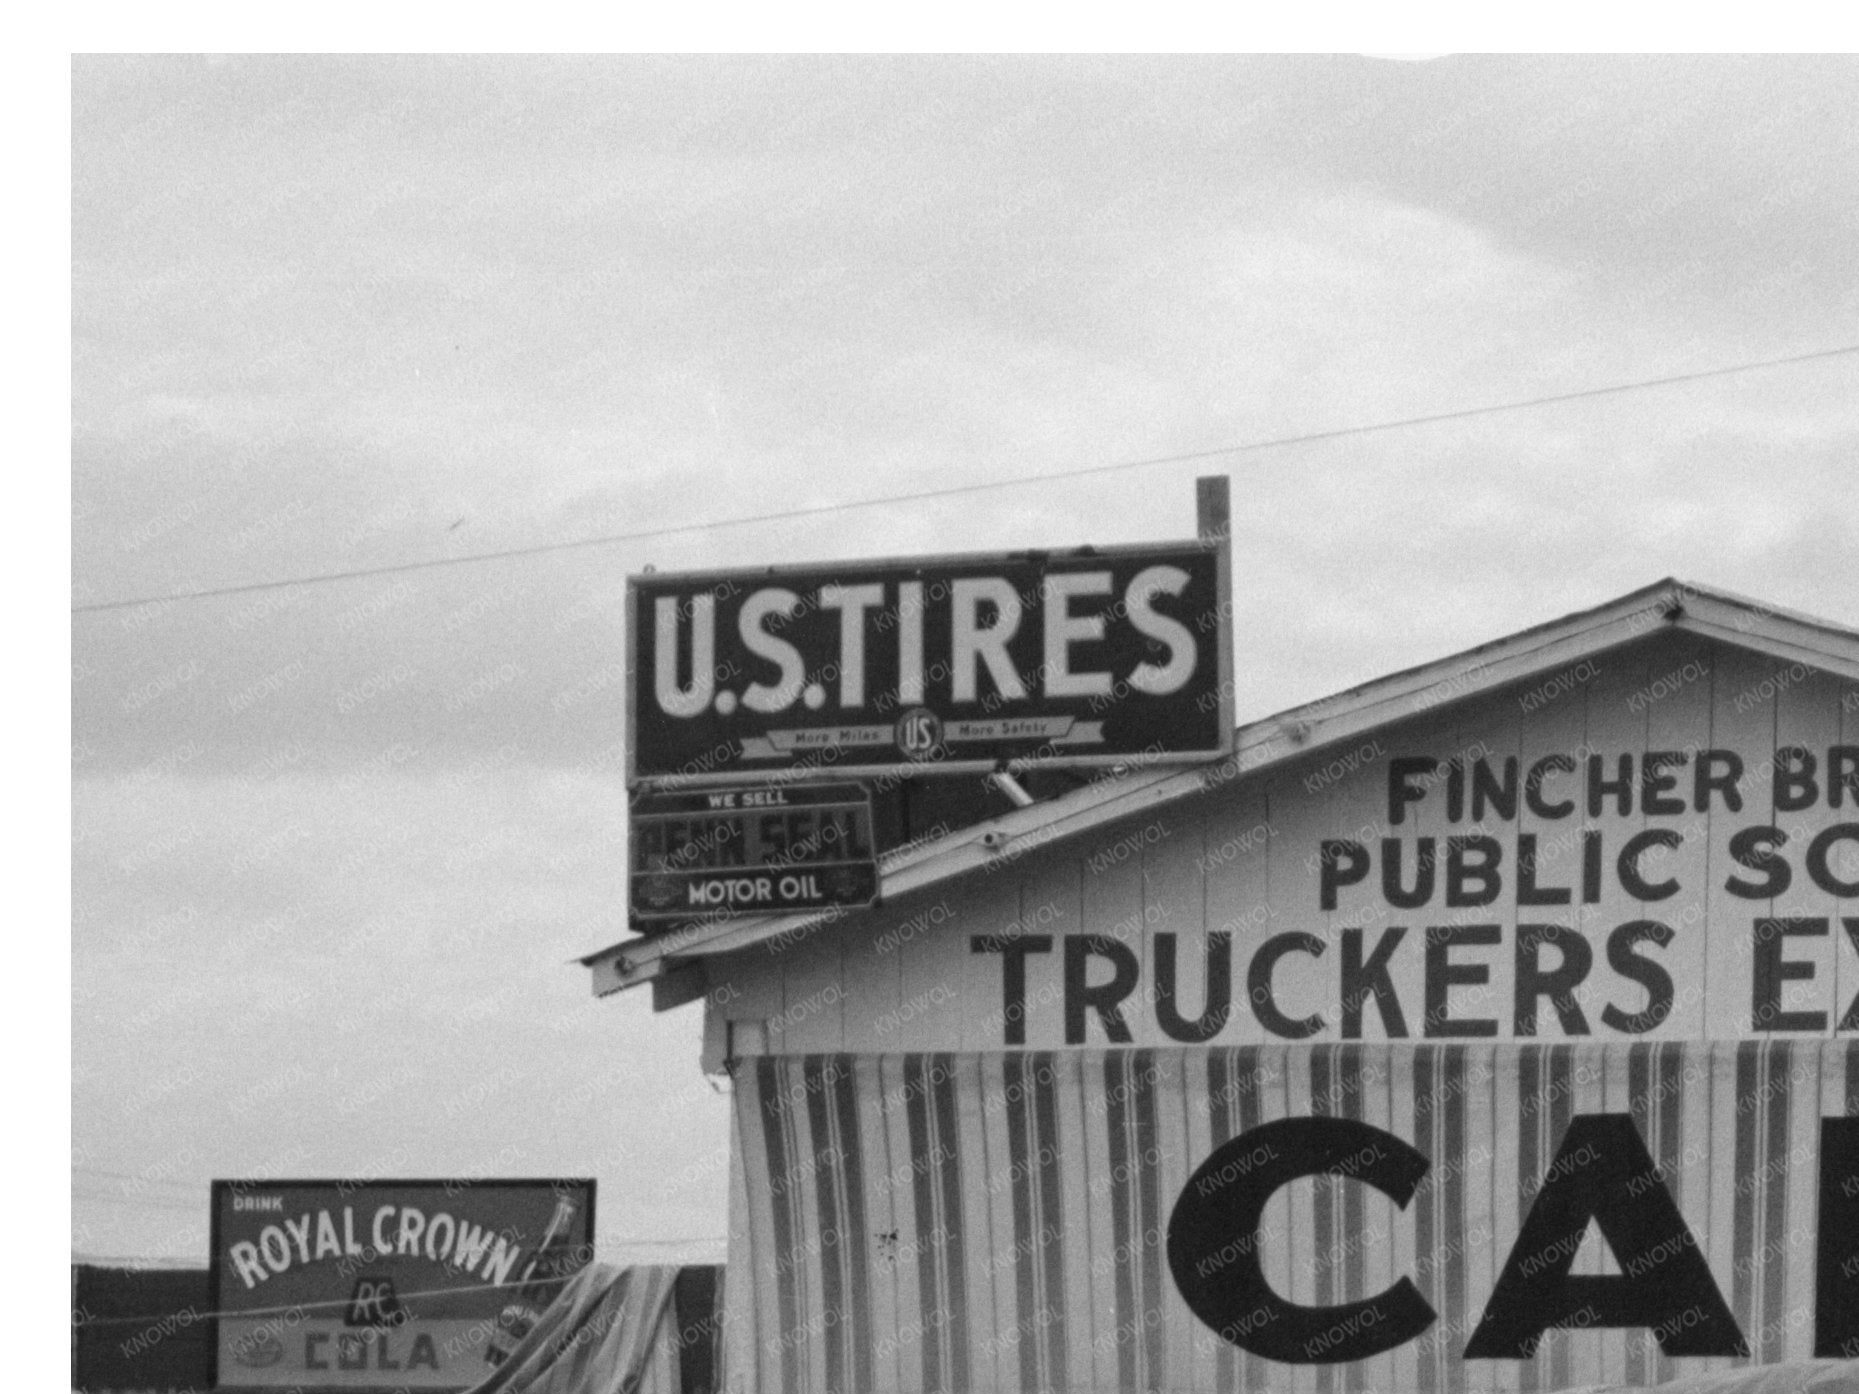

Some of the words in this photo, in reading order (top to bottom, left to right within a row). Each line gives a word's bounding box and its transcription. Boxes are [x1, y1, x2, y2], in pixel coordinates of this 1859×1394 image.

[795, 730, 833, 745] More
[839, 729, 880, 743] Miles
[905, 719, 931, 751] US
[959, 722, 996, 737] More
[1001, 720, 1049, 737] Safety
[709, 794, 737, 809] WE
[743, 790, 788, 807] SELL
[1388, 749, 1743, 824] FINCHER
[1319, 829, 1684, 911] PUBLIC
[689, 878, 772, 906] MOTOR
[779, 876, 823, 900] OIL
[970, 919, 1677, 1048] TRUCKERS
[233, 1196, 283, 1211] DRINK
[229, 1205, 363, 1289] ROYAL
[372, 1204, 520, 1288] CROWN
[352, 1281, 397, 1321] RC
[305, 1332, 439, 1370] COLA
